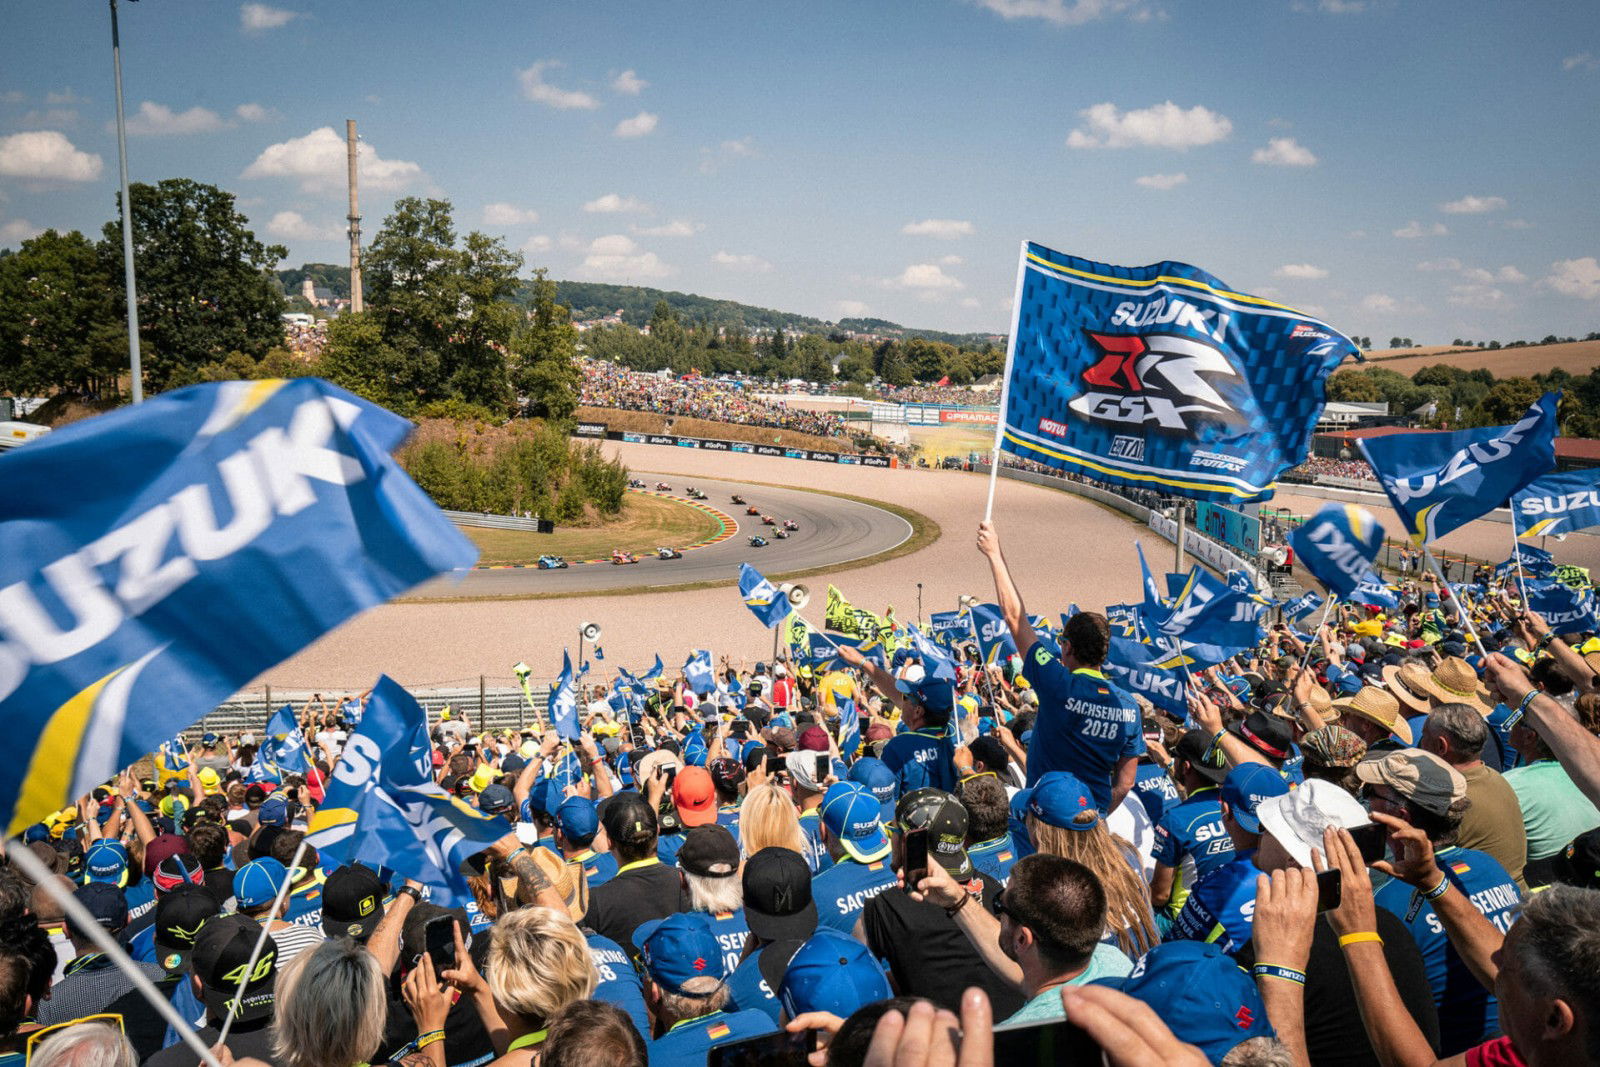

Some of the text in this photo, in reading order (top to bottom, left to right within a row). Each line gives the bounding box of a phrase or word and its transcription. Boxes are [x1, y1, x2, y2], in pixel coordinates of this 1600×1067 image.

[1110, 296, 1230, 344] SUZUKI
[1038, 418, 1068, 437] MOTUL
[1064, 697, 1137, 723] SACHSENRING
[1081, 717, 1119, 740] 2018
[222, 951, 275, 985] 46
